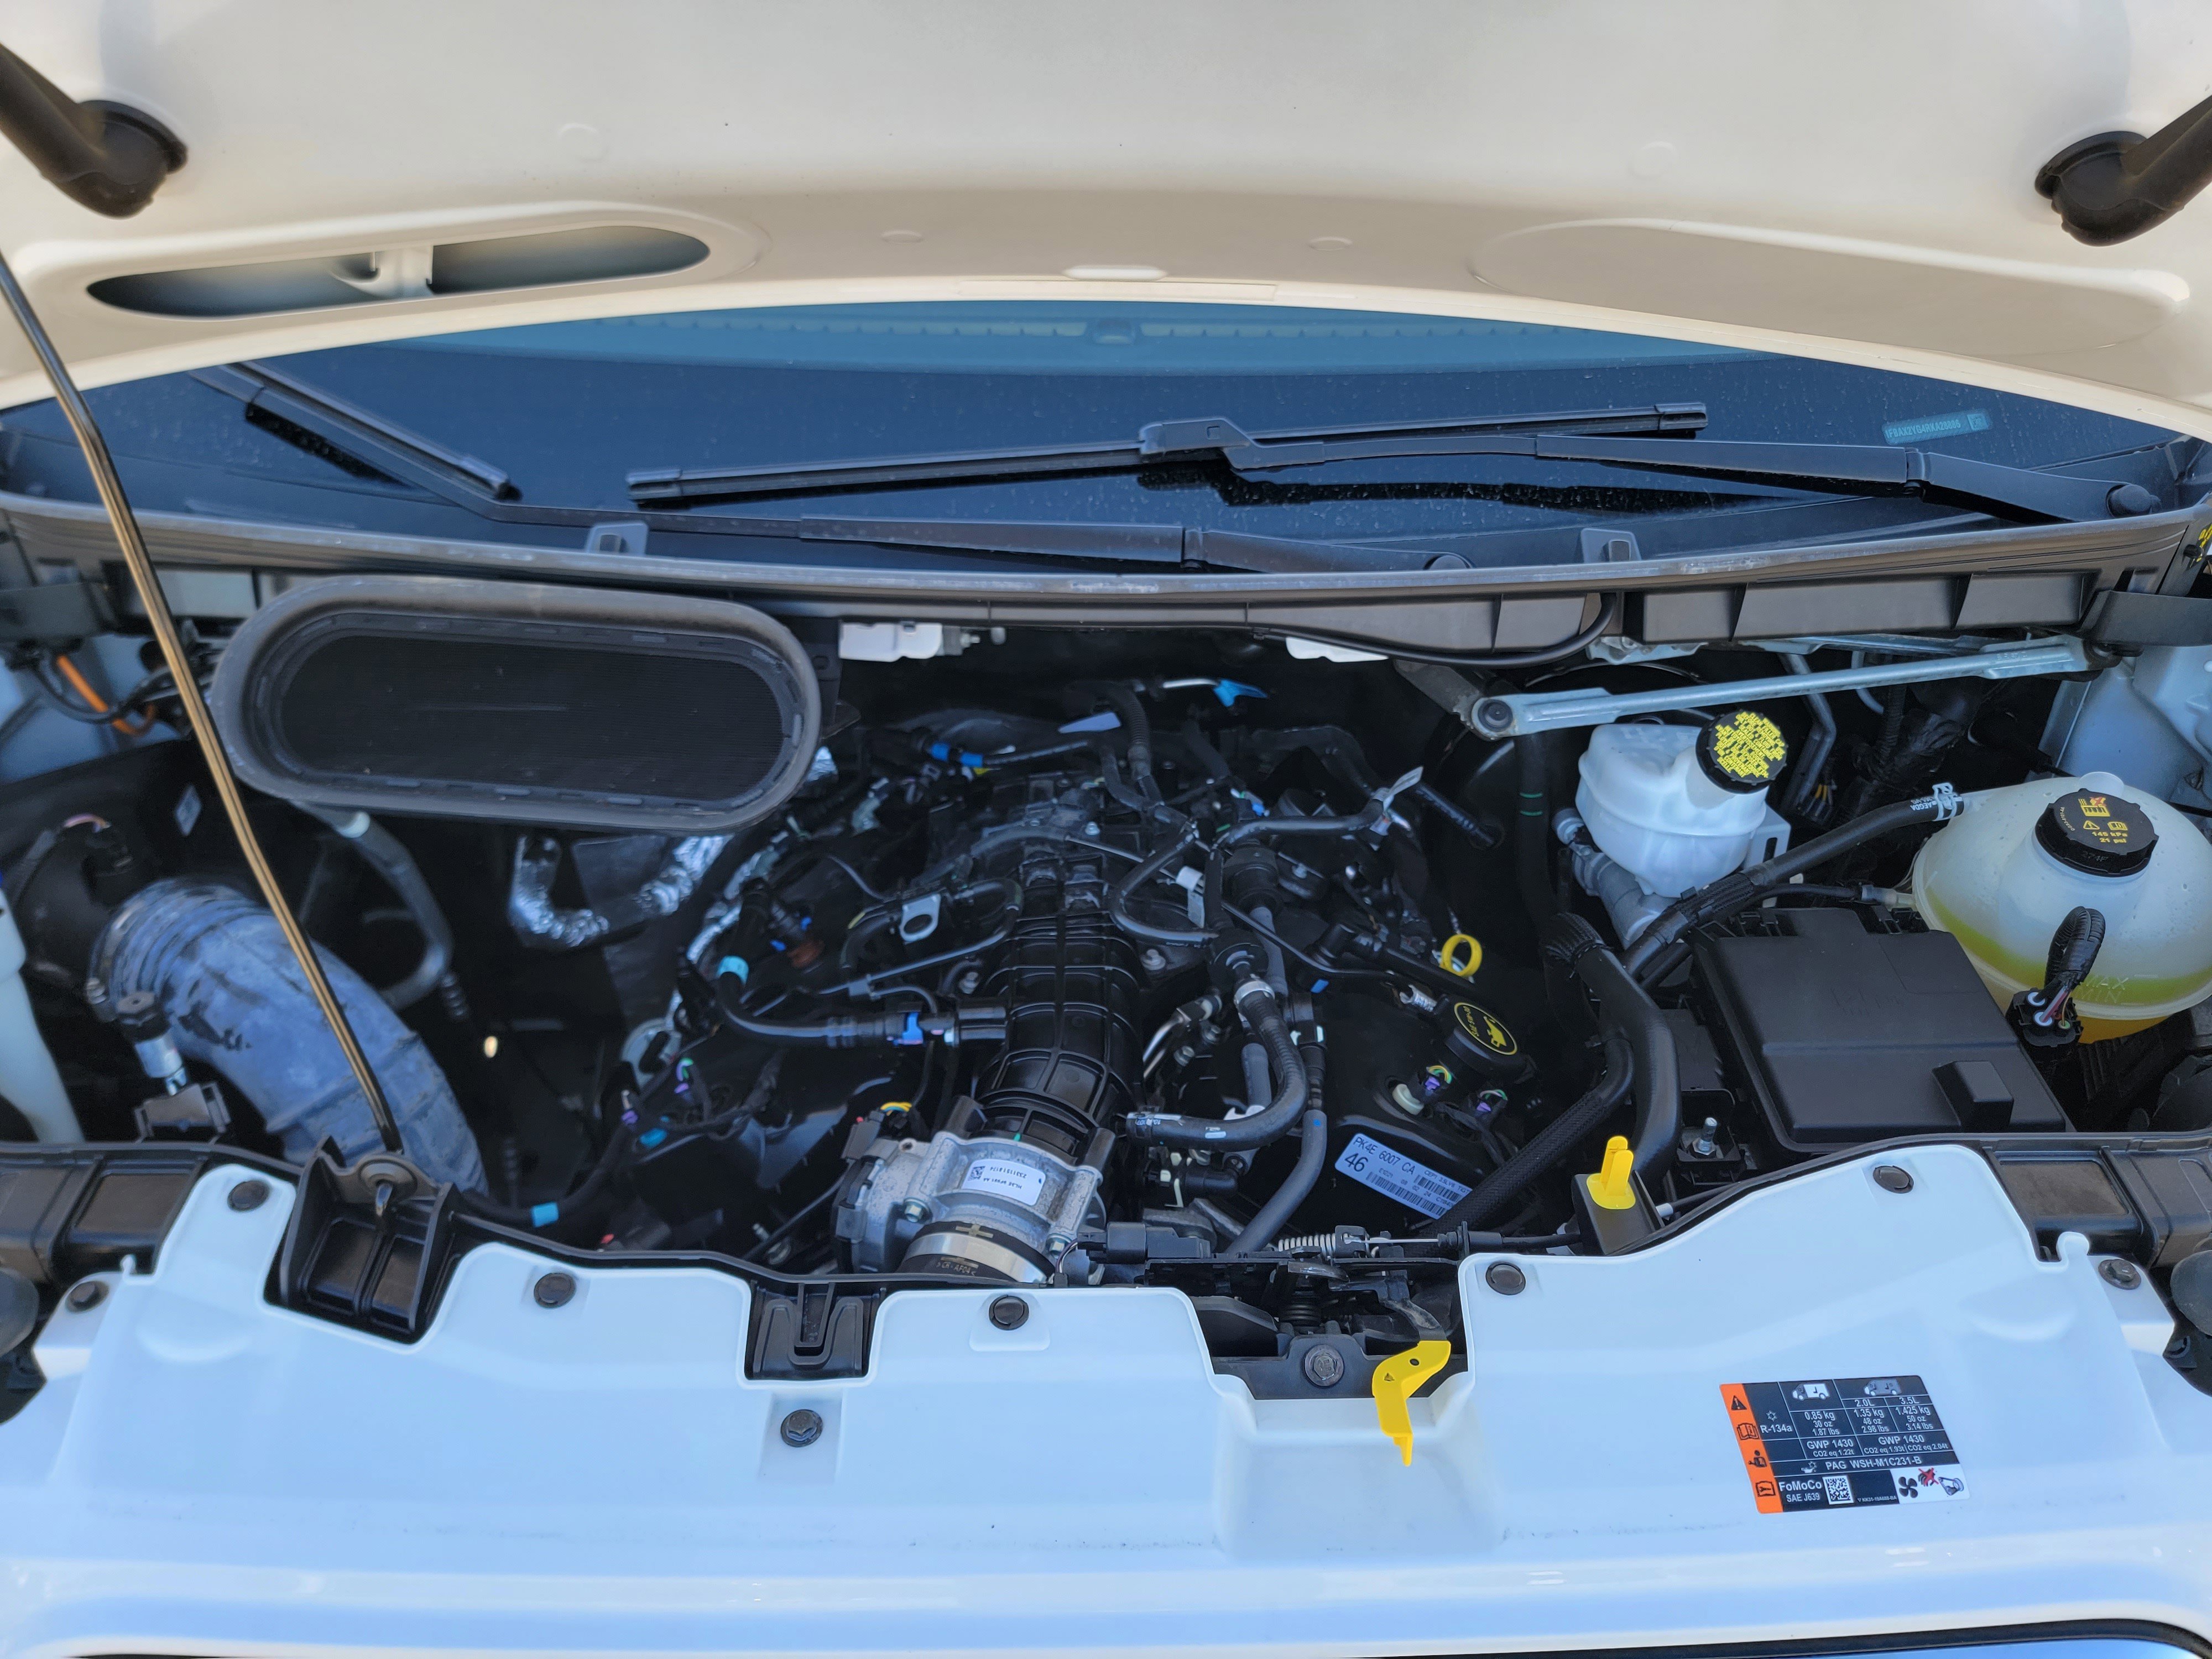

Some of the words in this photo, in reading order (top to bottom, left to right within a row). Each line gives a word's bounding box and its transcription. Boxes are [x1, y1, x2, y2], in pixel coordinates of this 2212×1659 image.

[1885, 419, 1961, 439] 1FBAX2YG4RKA28886
[1739, 725, 1752, 739] SEALED
[1750, 713, 1762, 726] CLEAN
[1762, 726, 1775, 739] FILLER
[1775, 738, 1785, 748] CAP
[1759, 737, 1770, 749] FLUID
[1353, 1137, 1378, 1154] PK4E
[1379, 1151, 1401, 1166] 6007
[1402, 1162, 1416, 1175] CA
[1344, 1153, 1368, 1172] 46
[1804, 1411, 1822, 1420] 0.85
[1823, 1411, 1835, 1421] kg
[1854, 1409, 1871, 1417] 1.35
[1872, 1408, 1885, 1418] kg
[1895, 1406, 1917, 1415] 1.425
[1918, 1406, 1931, 1416] kg
[1760, 1424, 1792, 1434] R-134a
[1807, 1440, 1829, 1449] GWP
[1832, 1439, 1854, 1448] 1430
[1878, 1436, 1901, 1445] GWP
[1903, 1434, 1924, 1443] 1430
[1825, 1461, 1846, 1470] PAG
[1850, 1456, 1922, 1469] WSH-M1C231-B
[1778, 1480, 1822, 1491] FoMoCo
[1786, 1494, 1803, 1503] SAE
[1803, 1493, 1820, 1501] J639
